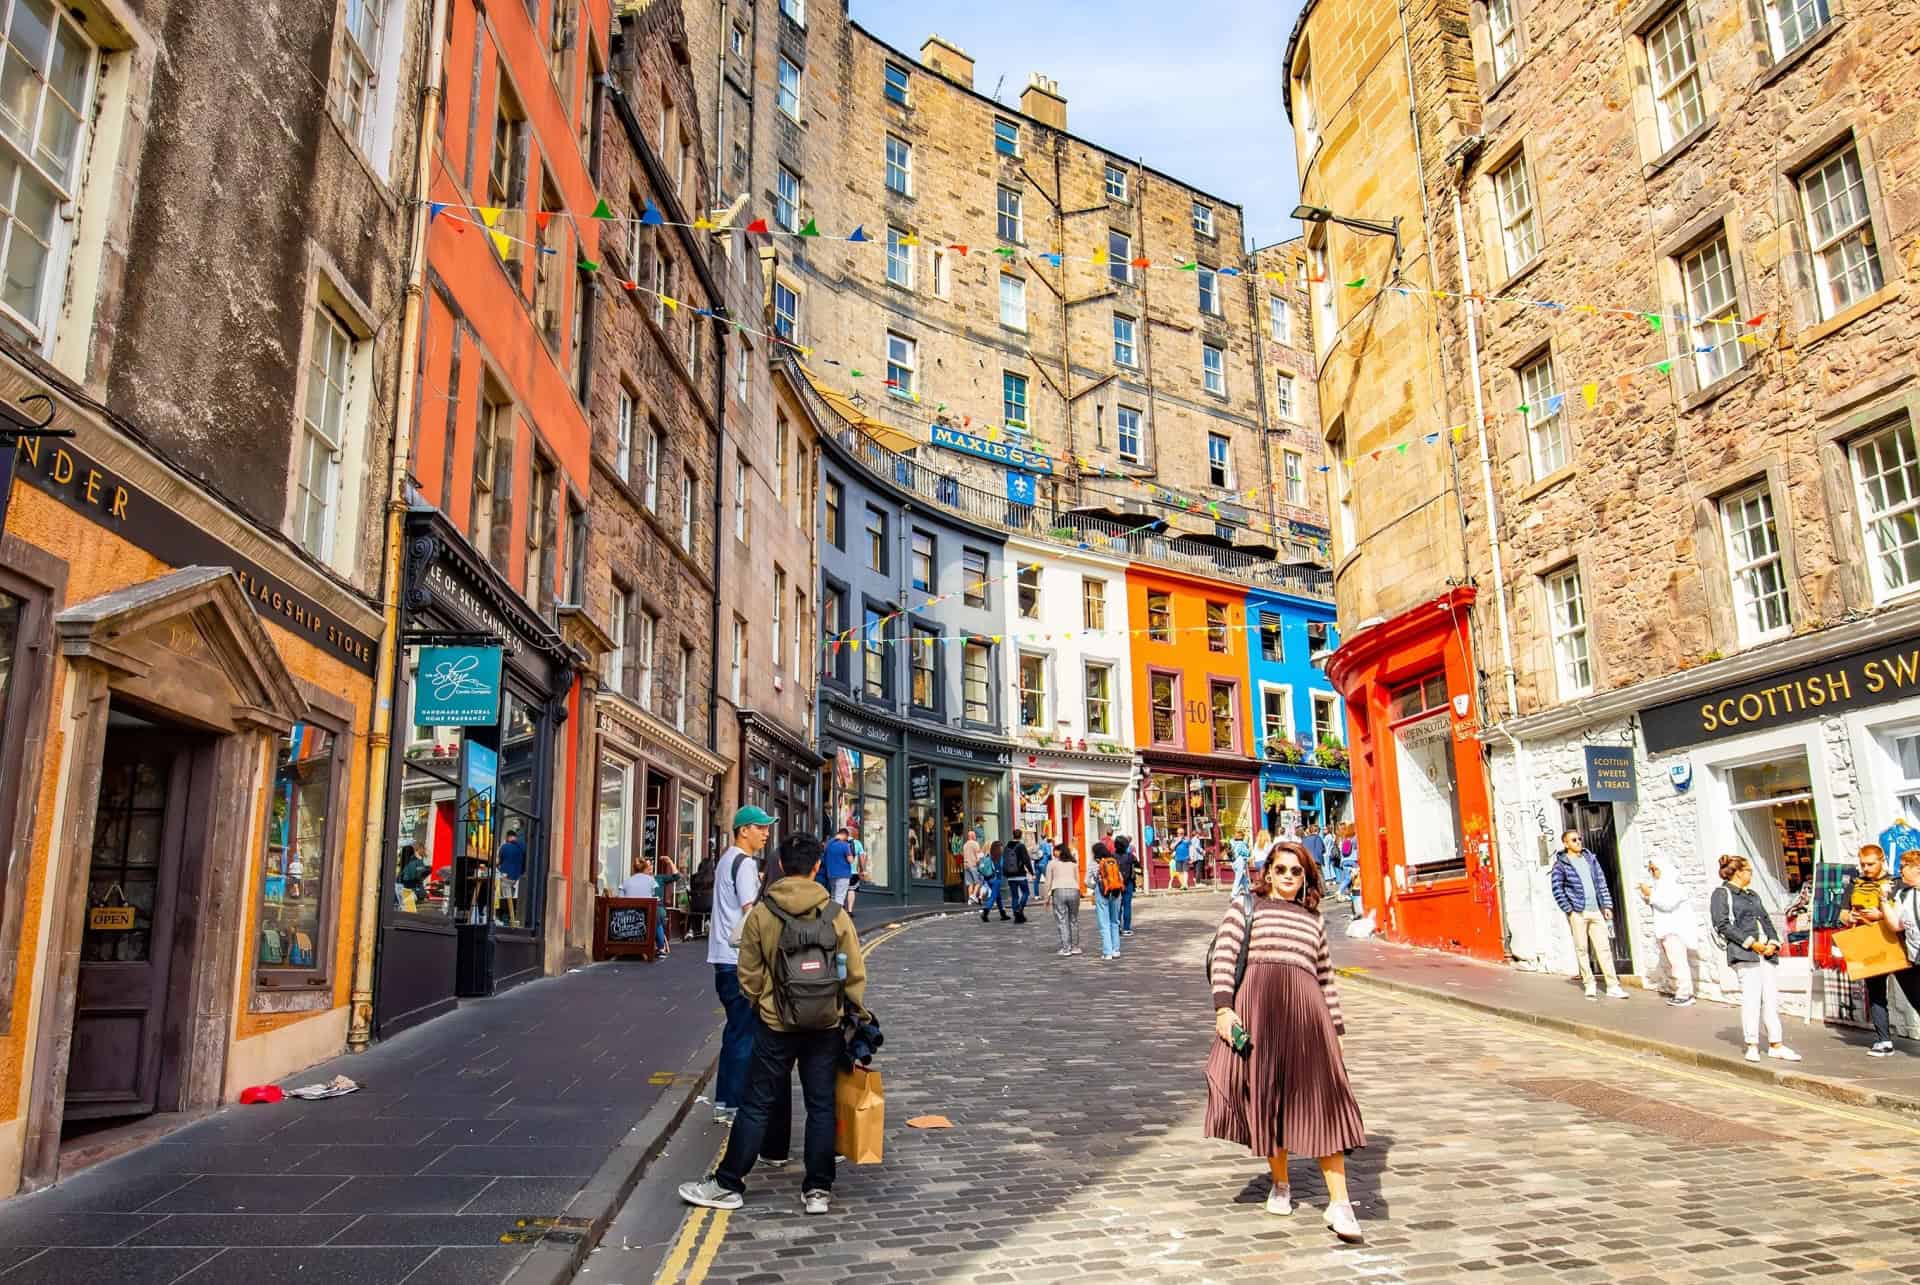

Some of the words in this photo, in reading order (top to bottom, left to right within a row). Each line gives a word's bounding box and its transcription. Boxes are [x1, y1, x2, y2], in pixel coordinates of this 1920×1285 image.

[935, 428, 1024, 463] MAXIES
[239, 570, 321, 633] FLAGSHIP
[329, 625, 369, 664] STORE
[444, 575, 457, 594] OF
[460, 588, 481, 617] SKYE
[482, 609, 511, 643] CANDLE
[1701, 670, 1851, 732] SCOTTISH
[1863, 650, 1920, 693] SW
[1187, 699, 1207, 724] 40
[600, 714, 613, 732] 89
[997, 752, 1009, 765] 44
[1593, 758, 1629, 767] SCOTTISH
[1598, 769, 1627, 778] SWEETS
[1596, 781, 1602, 789] &
[1604, 780, 1631, 789] TREATS
[94, 913, 129, 925] OPEN
